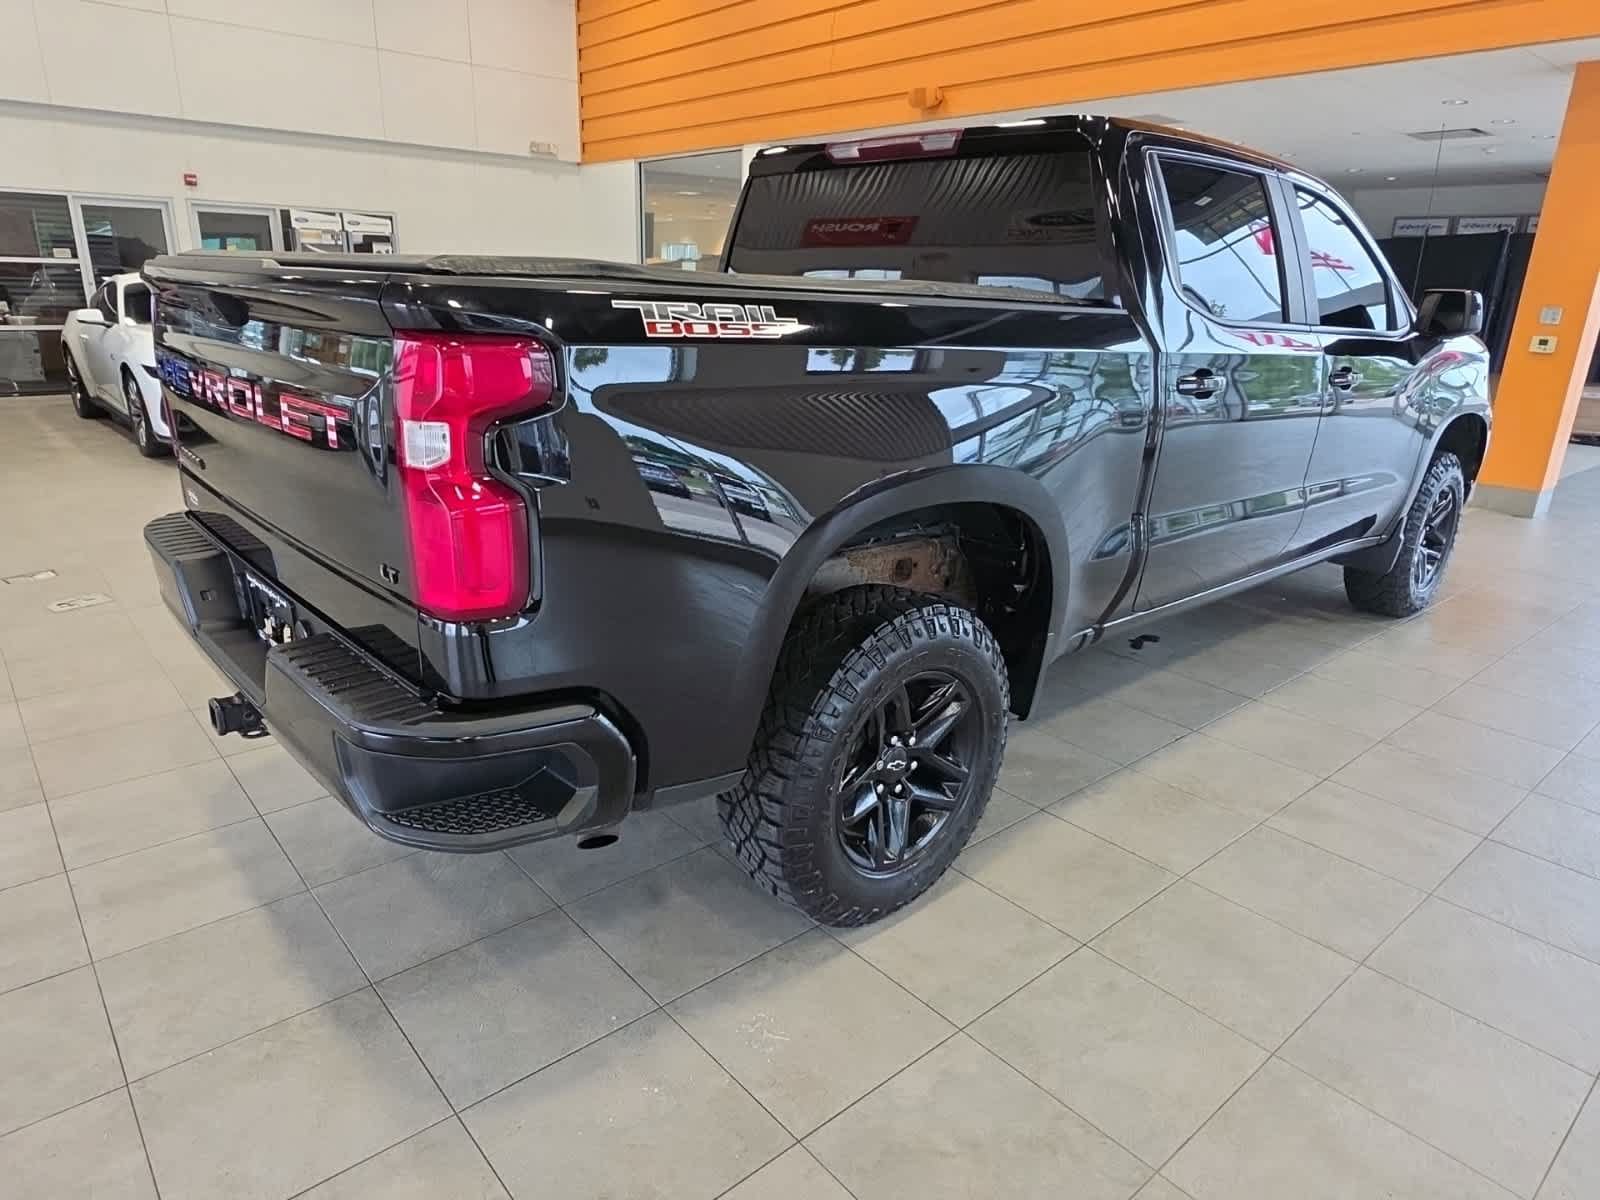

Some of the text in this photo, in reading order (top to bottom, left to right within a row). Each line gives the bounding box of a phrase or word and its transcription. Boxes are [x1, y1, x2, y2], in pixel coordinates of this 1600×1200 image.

[611, 300, 798, 324] TRAIL
[644, 320, 783, 338] BOSS
[379, 562, 400, 584] LT
